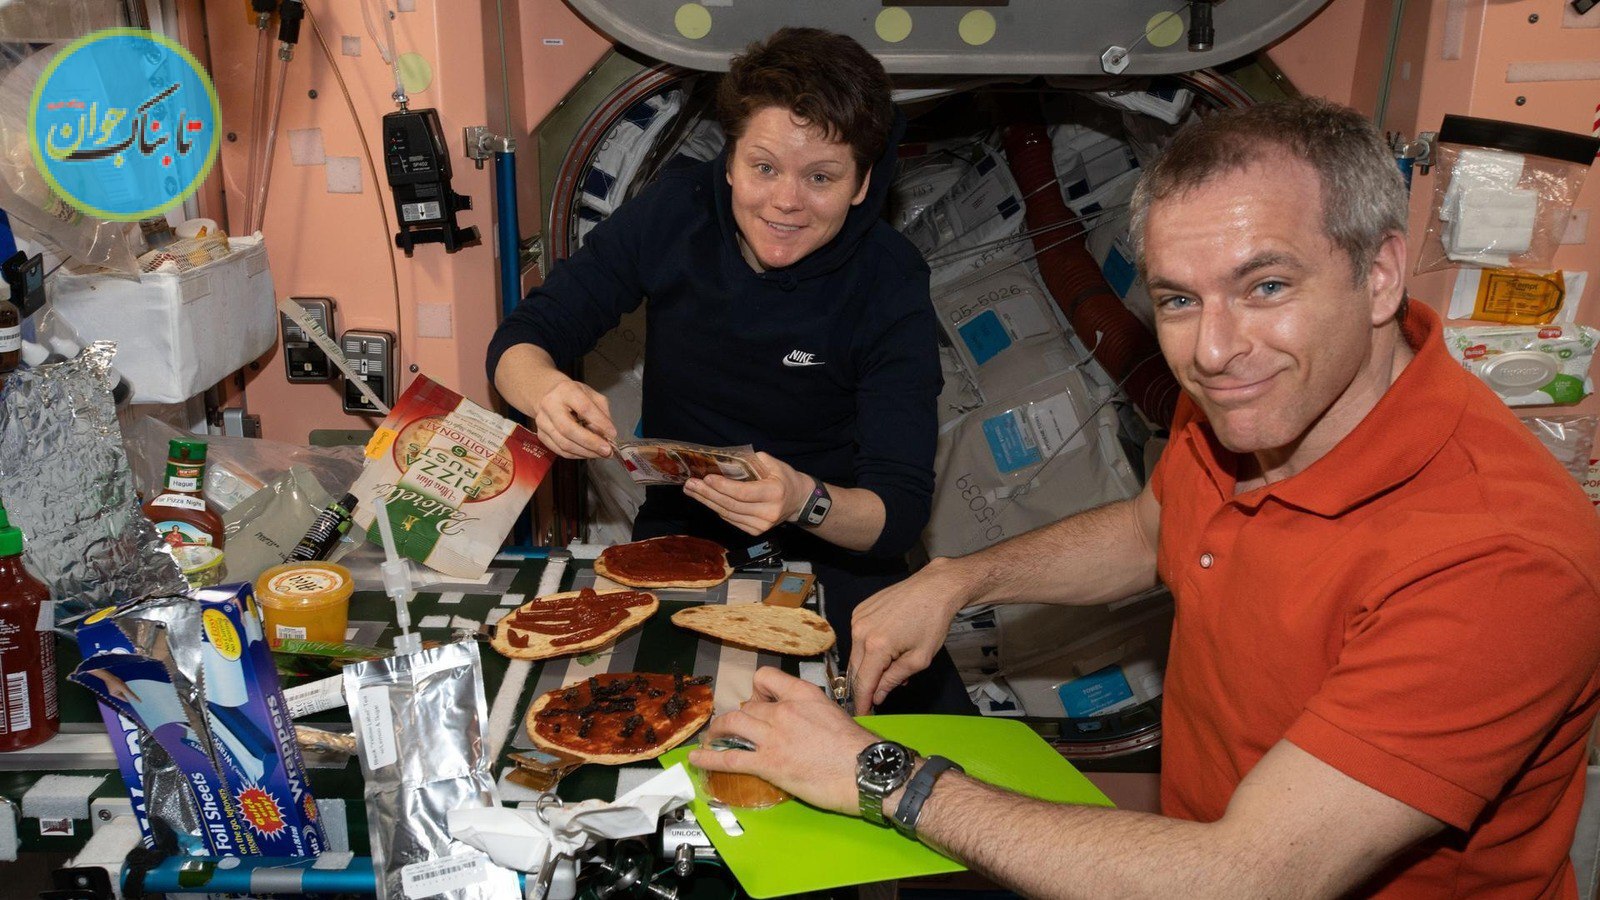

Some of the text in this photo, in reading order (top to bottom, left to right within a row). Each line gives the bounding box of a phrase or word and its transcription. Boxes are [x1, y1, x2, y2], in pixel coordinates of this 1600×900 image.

[788, 349, 815, 364] NIKE
[426, 420, 511, 470] TRADITIONAL
[406, 453, 481, 498] PIZZA
[408, 442, 493, 486] CRUSTS
[166, 496, 184, 504] Pizza
[267, 693, 303, 804] Wrappers
[191, 772, 221, 820] Sheets
[218, 788, 235, 818] leftovers
[257, 796, 279, 822] Easy!
[244, 797, 266, 826] Quick
[210, 823, 232, 850] Foil
[234, 830, 244, 844] the
[671, 829, 702, 837] UNLOCK
